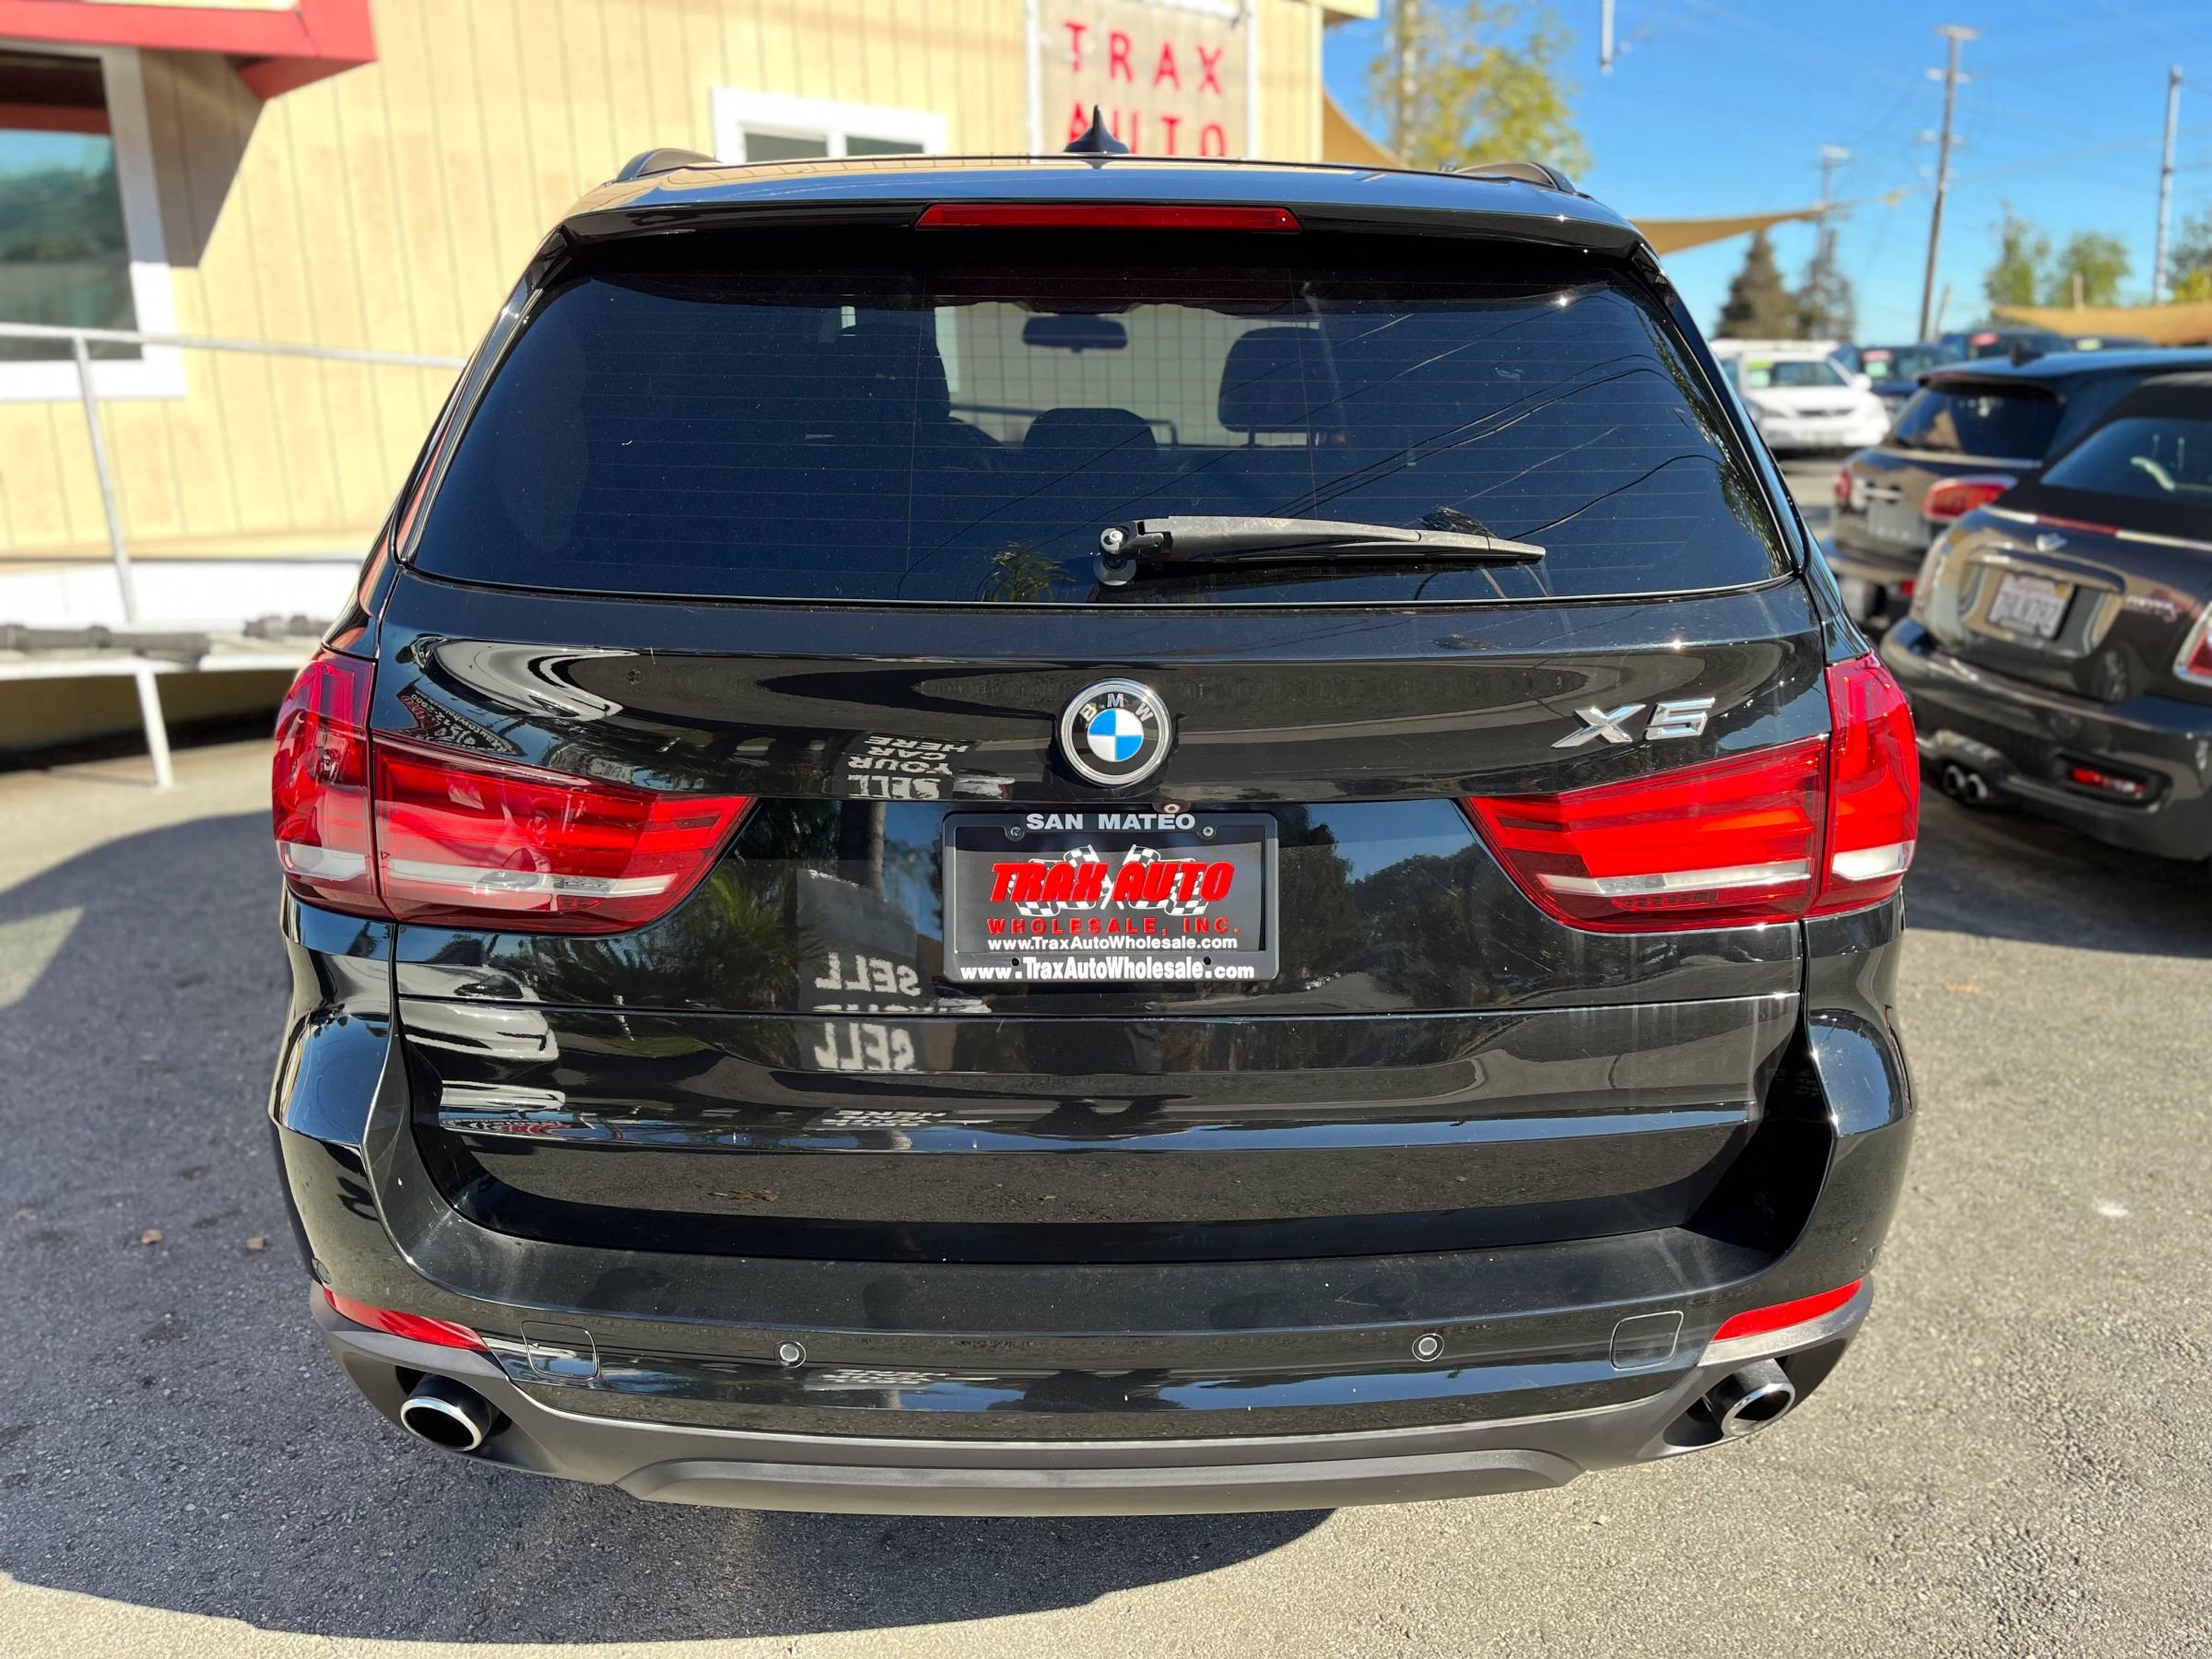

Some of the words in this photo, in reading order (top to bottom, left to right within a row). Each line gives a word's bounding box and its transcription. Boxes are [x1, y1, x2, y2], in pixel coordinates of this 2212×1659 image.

[1065, 21, 1223, 94] TRAX
[1079, 692, 1153, 722] BMW
[1550, 697, 1715, 749] X5
[1026, 814, 1085, 830] SAN
[1098, 814, 1196, 830] MATEO
[990, 861, 1109, 902] TRAX
[1111, 861, 1235, 902] AUTO
[987, 917, 1168, 936] WHOLESALE,
[1182, 916, 1241, 935] INC.
[987, 935, 1238, 950] www.TraxAutoWholesale.com
